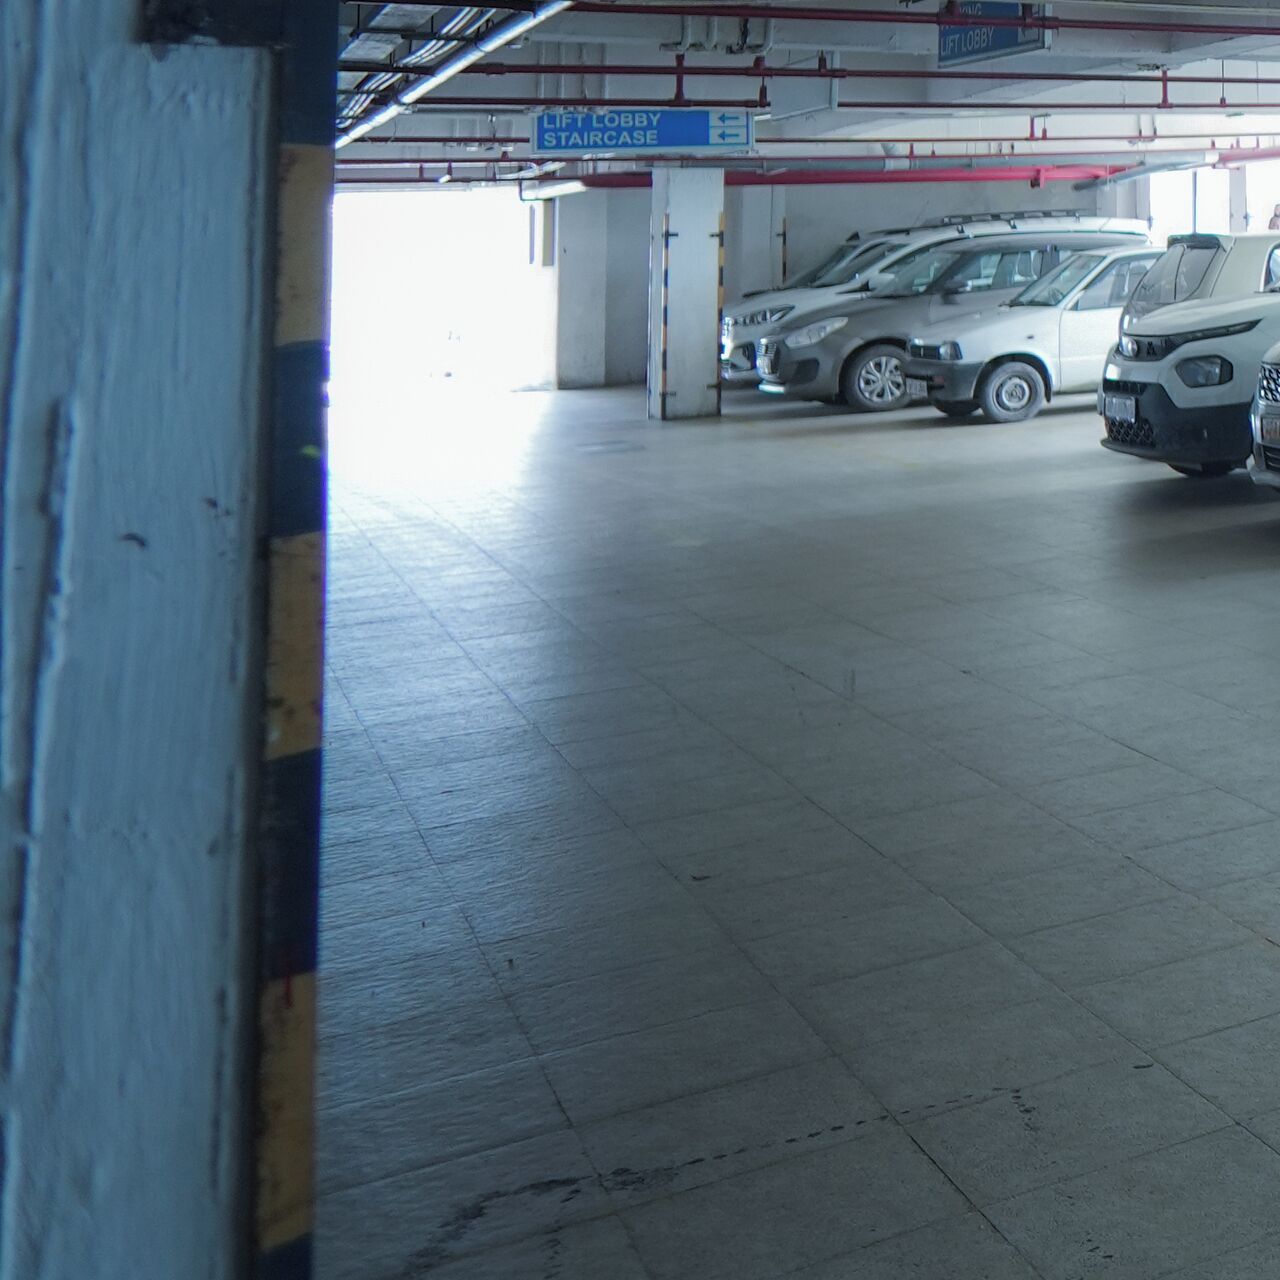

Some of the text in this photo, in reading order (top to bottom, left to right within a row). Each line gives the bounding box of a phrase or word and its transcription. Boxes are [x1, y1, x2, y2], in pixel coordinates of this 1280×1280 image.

[941, 26, 994, 56] LIFT LOBBY
[543, 112, 662, 129] LIFT LOBBY
[543, 130, 658, 147] STAIRCASE
